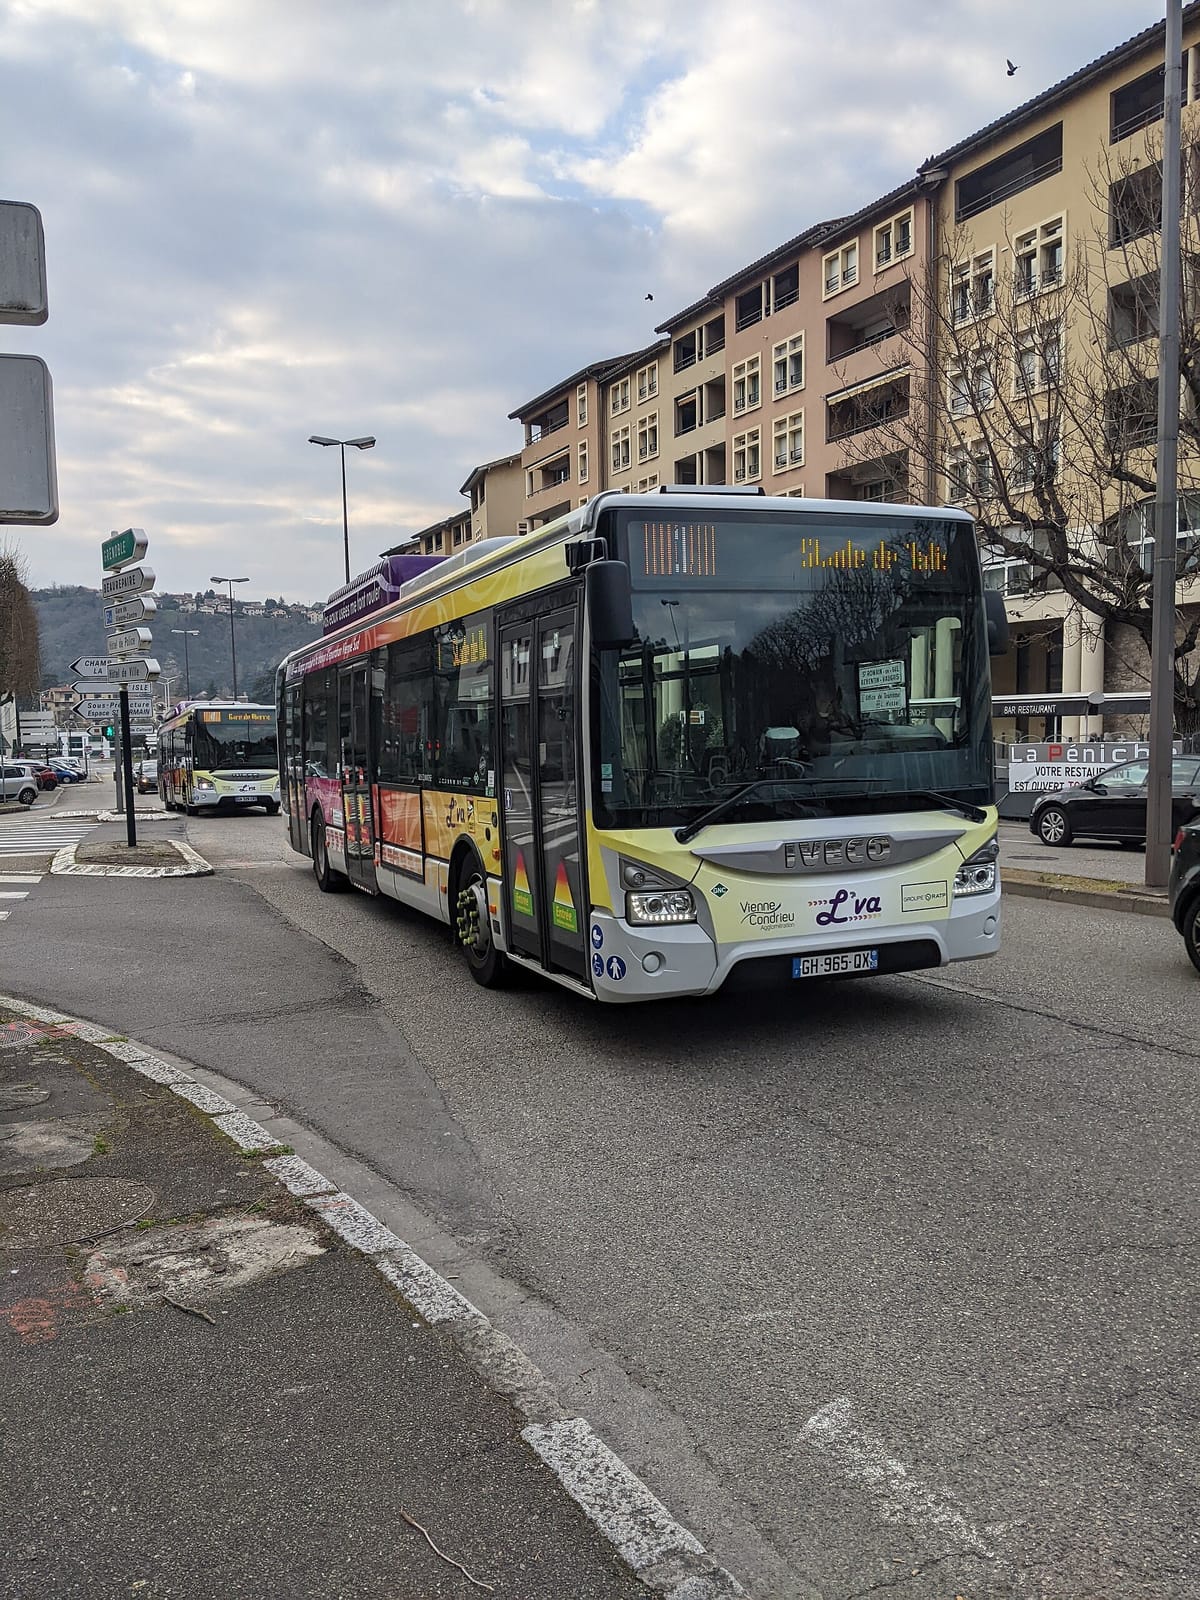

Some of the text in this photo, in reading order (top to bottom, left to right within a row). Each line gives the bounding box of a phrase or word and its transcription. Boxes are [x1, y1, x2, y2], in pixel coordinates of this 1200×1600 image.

[103, 574, 136, 594] BEAUREPAIRE
[87, 709, 110, 717] Espace
[1004, 704, 1056, 714] BAR RESTAURANT
[1011, 743, 1178, 763] La Pénich
[1035, 766, 1062, 777] VOTRE
[1015, 781, 1029, 791] EST
[1032, 781, 1065, 791] OUVERT
[784, 835, 891, 869] IVECO
[712, 886, 726, 894] GNC
[931, 892, 946, 900] RATP
[740, 901, 776, 914] Vienne
[816, 889, 882, 926] L'va
[749, 911, 795, 926] Condrieu
[802, 951, 870, 976] GH-965-QX
